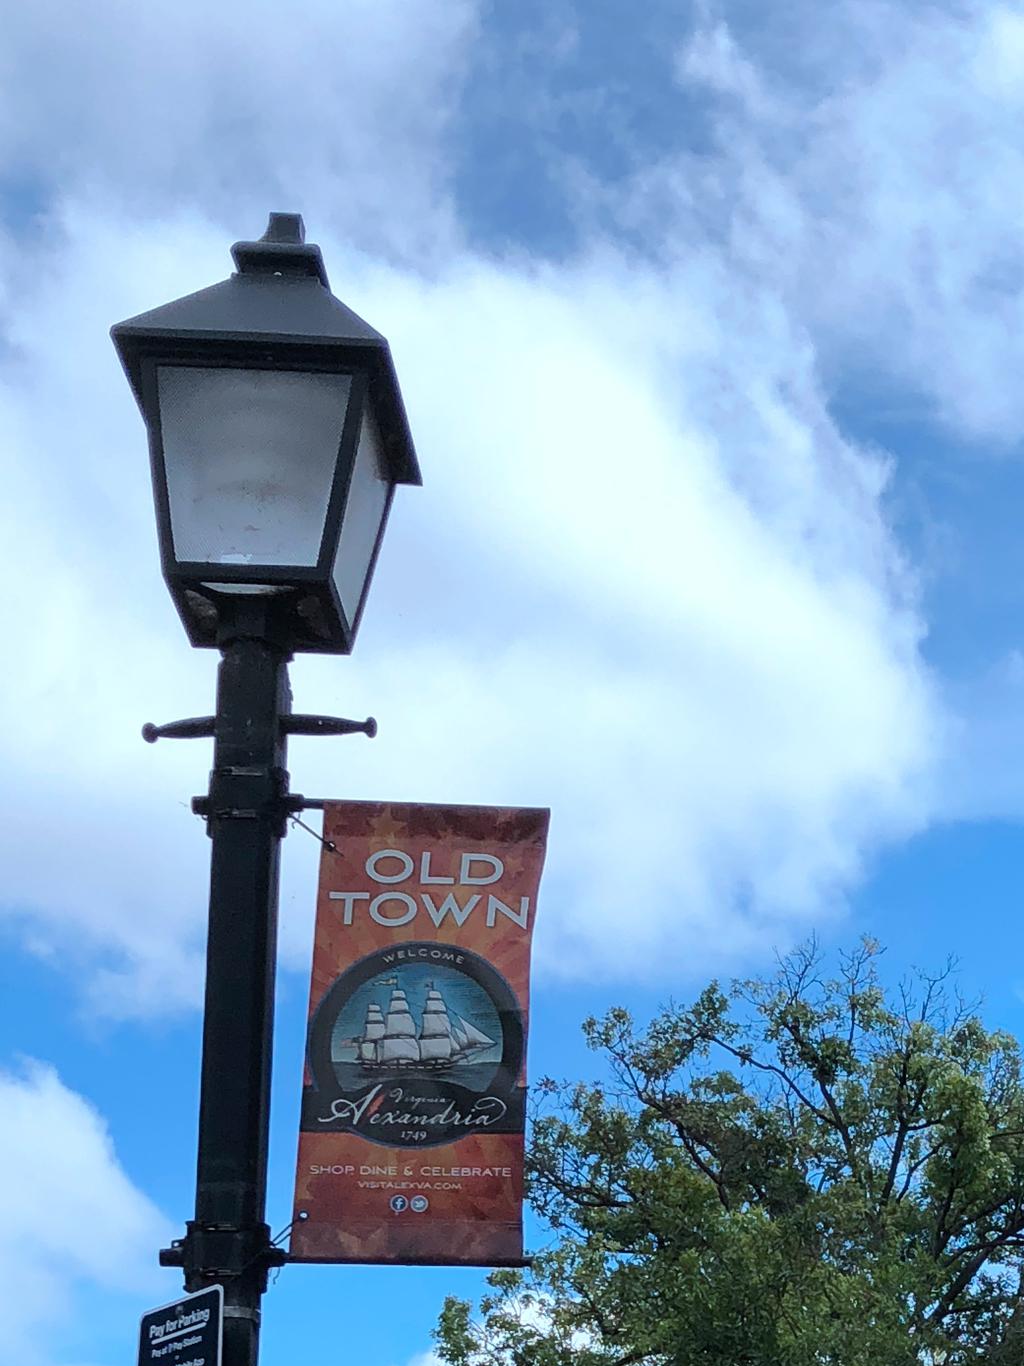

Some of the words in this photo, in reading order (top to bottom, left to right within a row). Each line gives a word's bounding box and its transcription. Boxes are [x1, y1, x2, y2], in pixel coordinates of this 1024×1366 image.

[365, 849, 504, 885] OLD
[329, 891, 529, 930] TOWN
[382, 948, 465, 964] WELCOME
[389, 1088, 446, 1109] Virginia
[401, 1130, 427, 1141] 1749
[359, 1165, 398, 1176] DINE
[403, 1166, 414, 1176] &
[420, 1166, 512, 1178] CELEBRATE
[357, 1180, 462, 1190] VISITALEXVA.COM
[149, 1324, 165, 1338] Pay
[166, 1319, 178, 1332] for
[178, 1308, 210, 1328] Parking
